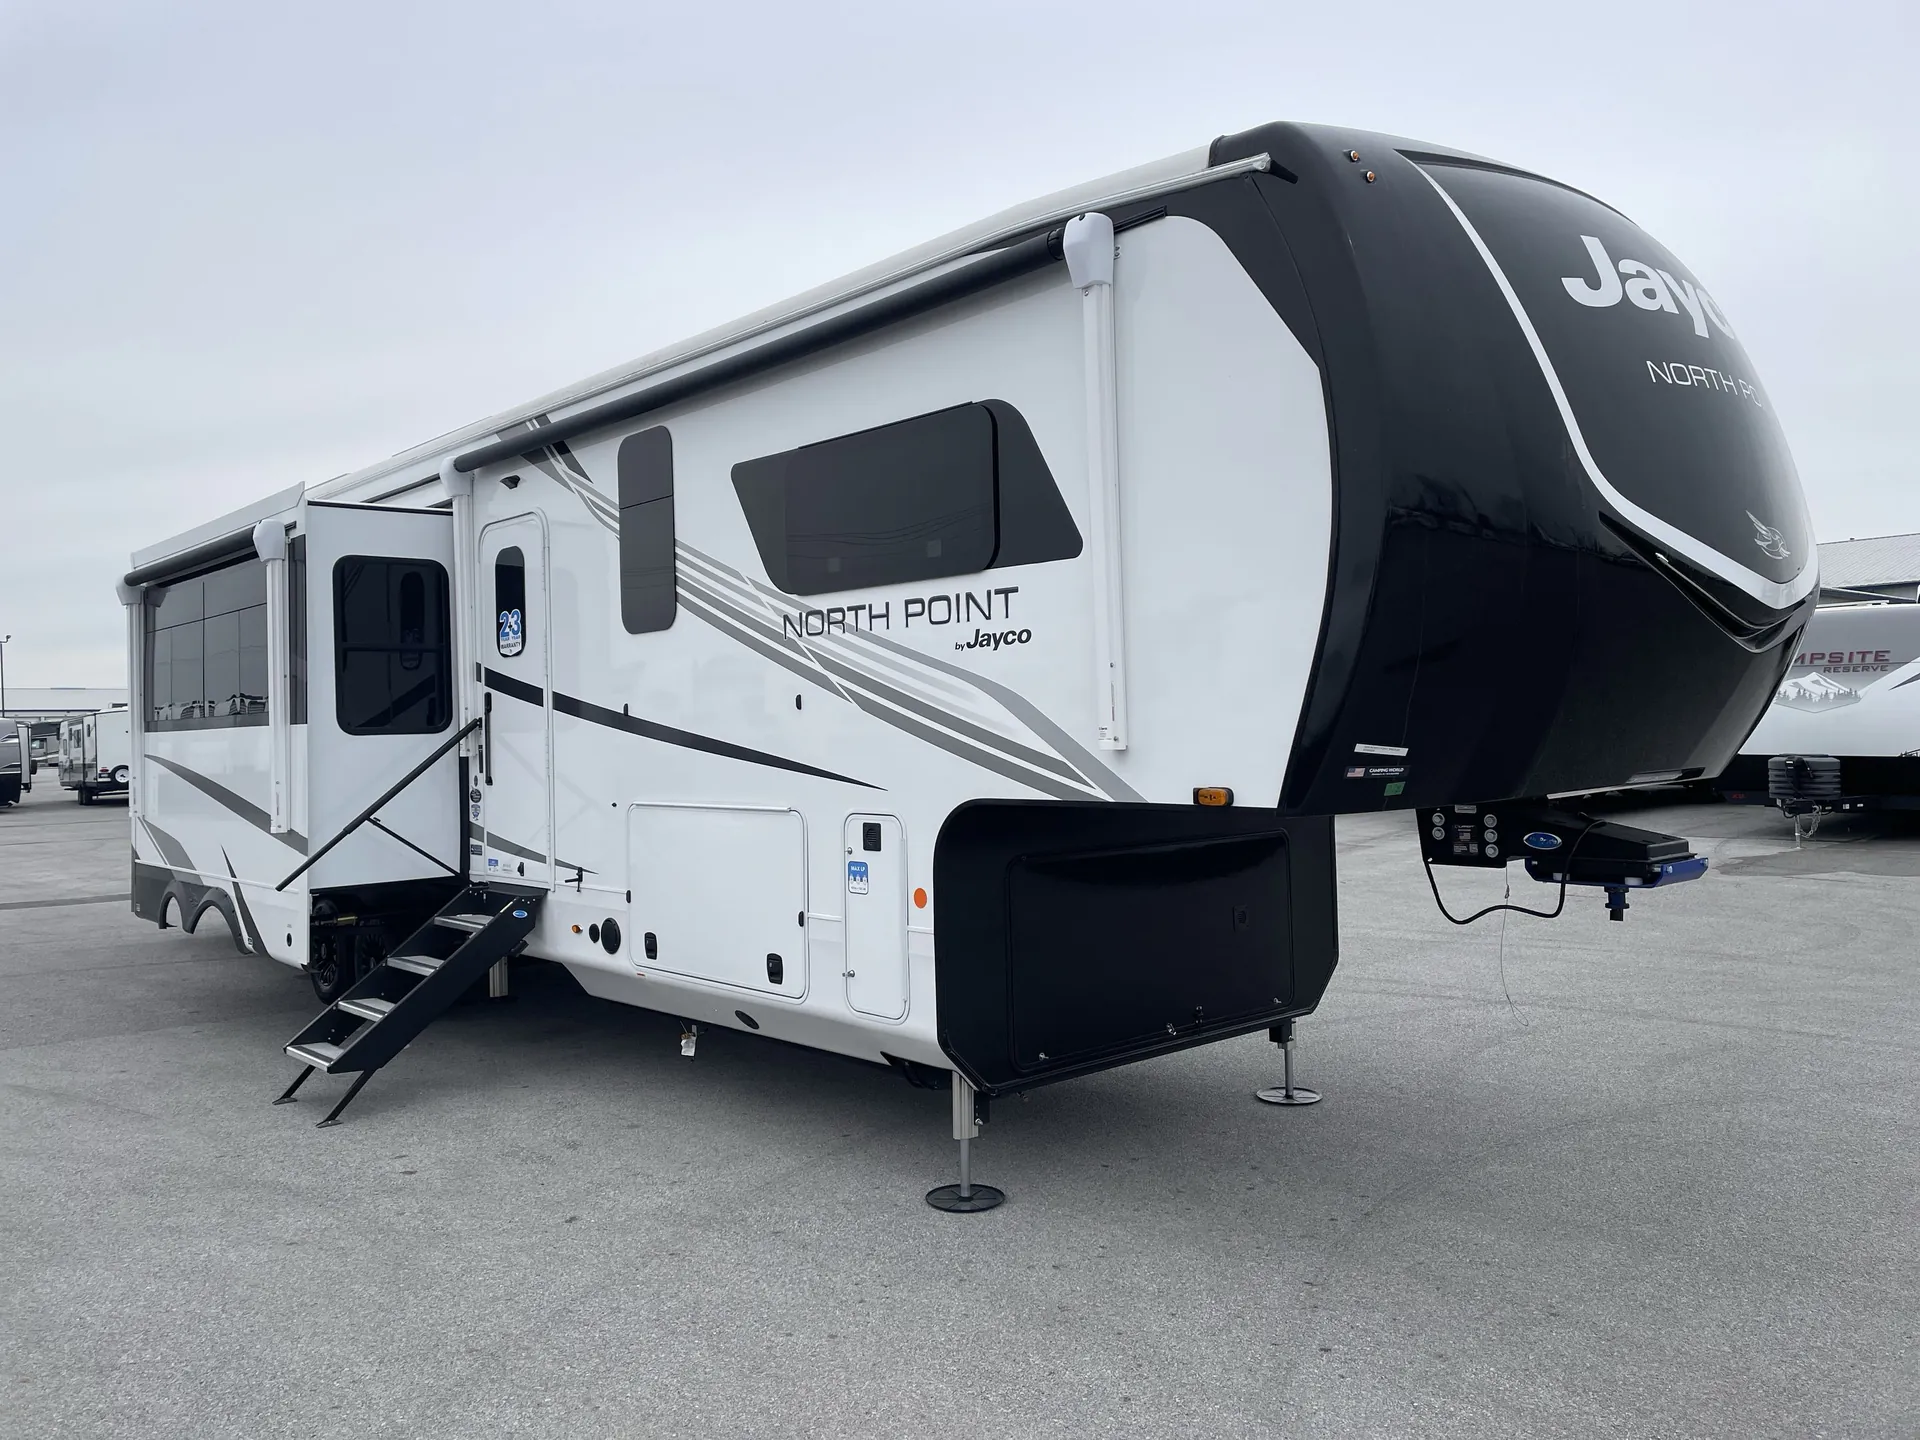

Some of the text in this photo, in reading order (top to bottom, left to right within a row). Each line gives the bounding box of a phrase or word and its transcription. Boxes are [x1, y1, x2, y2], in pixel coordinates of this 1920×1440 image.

[1646, 360, 1738, 395] NORTH
[783, 586, 1019, 640] NORTH POINT
[955, 628, 1032, 651] by Jayco
[1823, 664, 1889, 673] RESERVE
